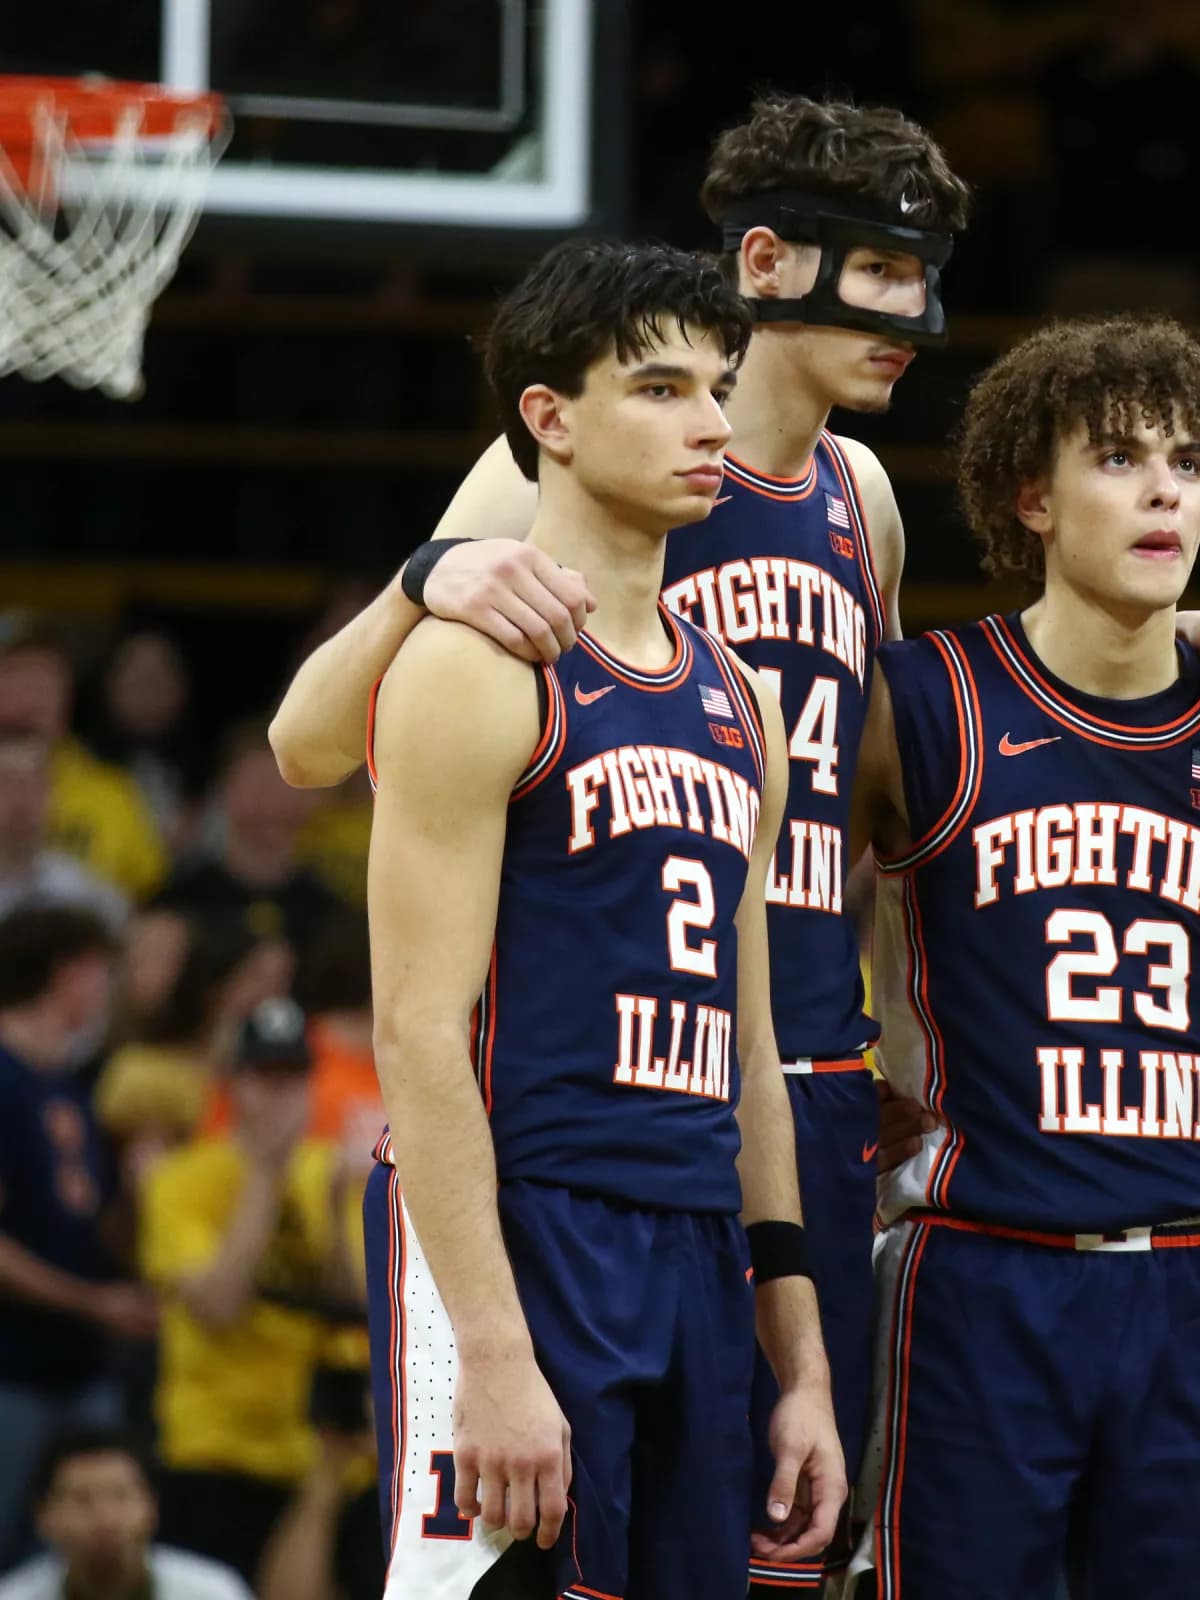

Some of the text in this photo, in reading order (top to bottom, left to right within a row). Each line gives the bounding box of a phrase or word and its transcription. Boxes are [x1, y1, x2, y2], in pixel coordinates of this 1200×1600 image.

[757, 666, 840, 797] 4
[661, 855, 718, 978] 2
[1045, 908, 1192, 1032] 23
[612, 993, 732, 1102] ILLINI
